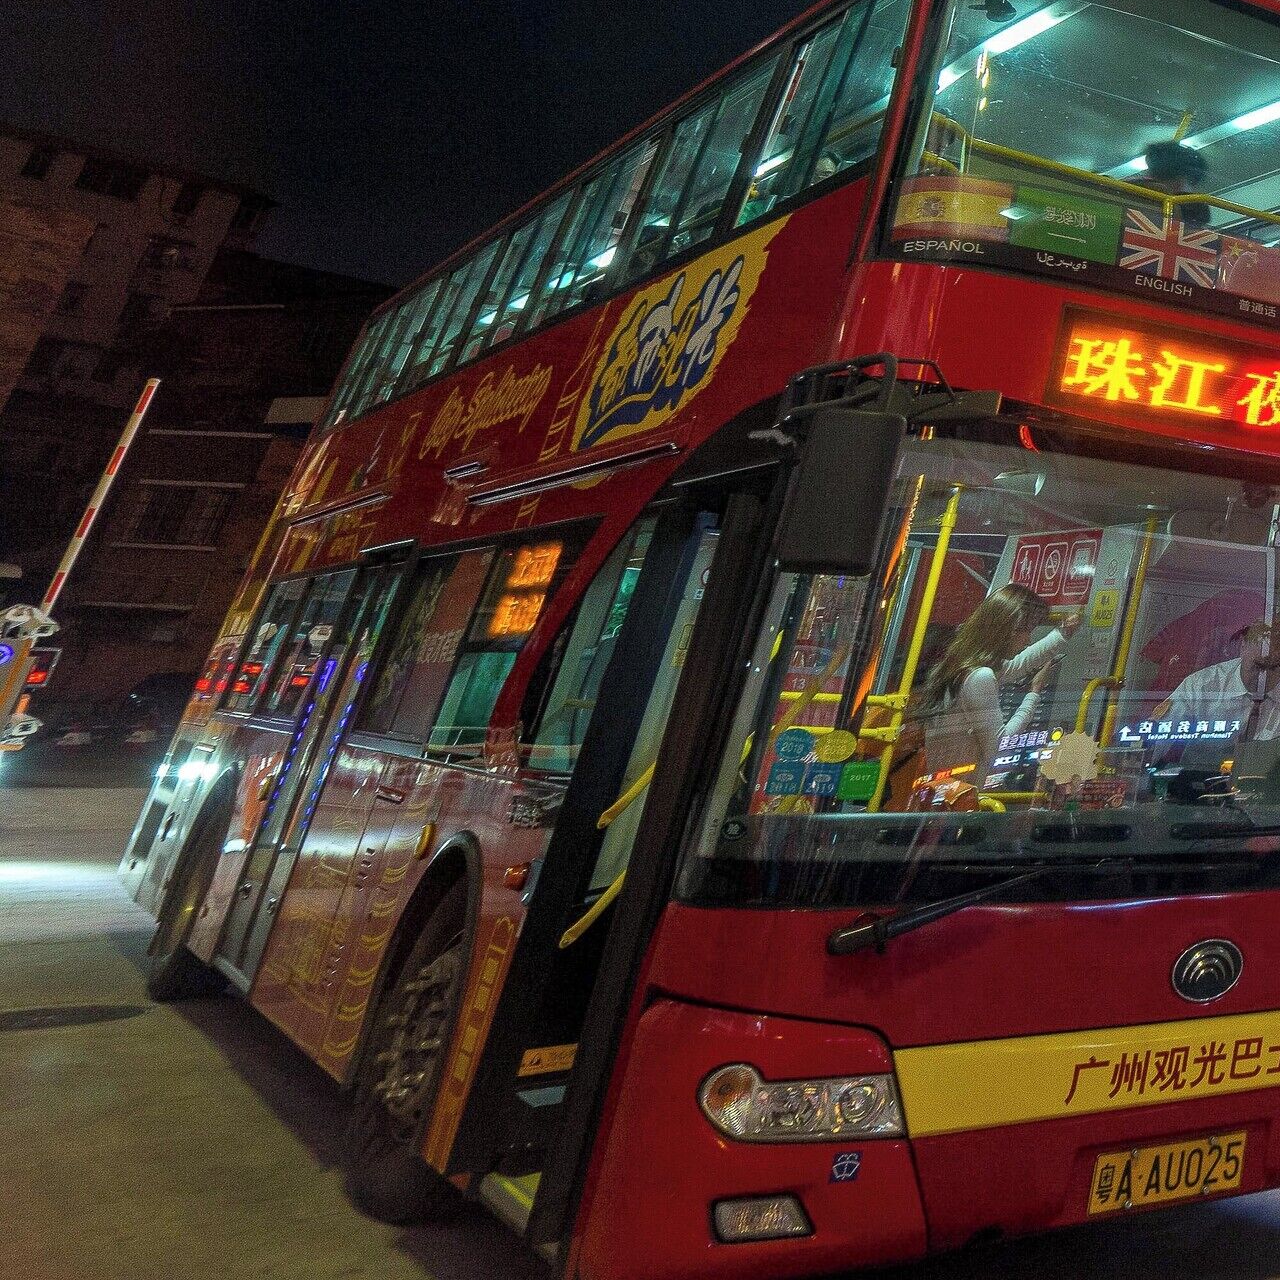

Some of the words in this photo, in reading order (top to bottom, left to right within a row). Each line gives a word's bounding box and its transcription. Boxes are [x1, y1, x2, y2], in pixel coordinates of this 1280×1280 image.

[903, 239, 985, 255] ESPAÑOL
[1134, 274, 1193, 297] ENGLISH
[1238, 298, 1277, 318] 普通话
